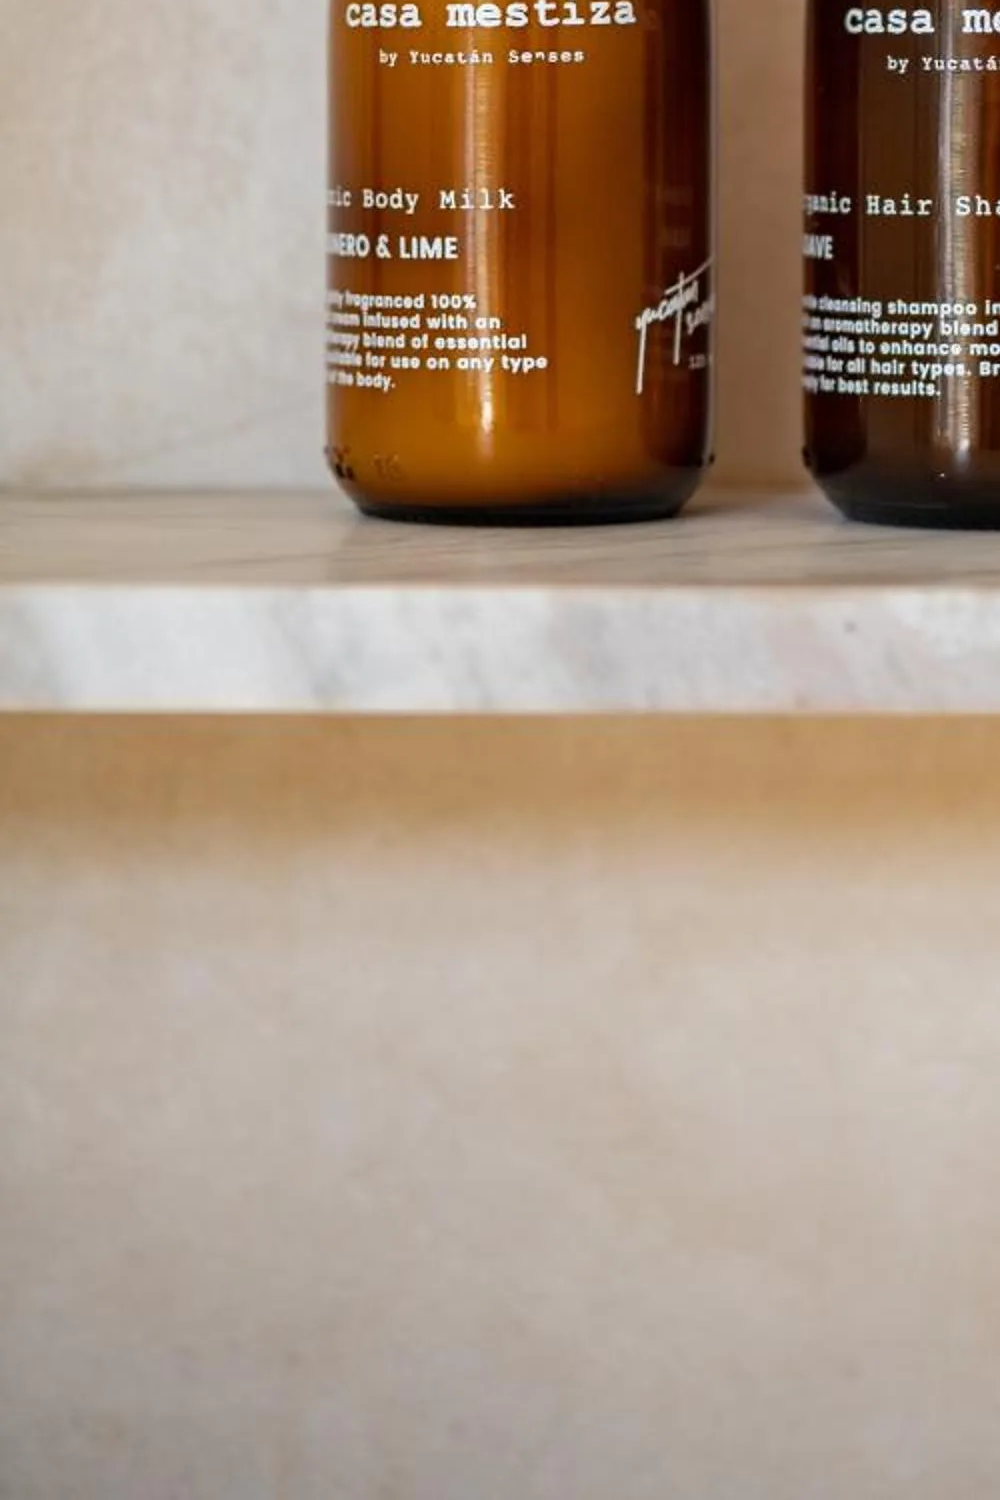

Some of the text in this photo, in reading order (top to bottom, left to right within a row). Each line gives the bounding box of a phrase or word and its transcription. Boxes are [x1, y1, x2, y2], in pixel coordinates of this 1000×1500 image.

[345, 2, 422, 28] casa
[845, 8, 934, 34] casa
[379, 50, 399, 66] by
[409, 50, 493, 65] Yucatán
[887, 56, 909, 72] by
[362, 188, 419, 214] Body
[439, 188, 516, 210] Milk
[865, 193, 933, 216] Hair
[375, 234, 392, 258] &
[399, 236, 459, 259] LIME
[431, 294, 477, 309] 100%
[887, 300, 977, 317] shampoo
[426, 313, 468, 329] with
[475, 316, 501, 329] an
[940, 319, 998, 337] blend
[363, 332, 405, 349] blend
[410, 333, 428, 349] of
[434, 335, 527, 349] essential
[858, 339, 875, 354] to
[880, 340, 962, 357] enhance
[366, 352, 386, 368] for
[390, 355, 420, 369] use
[426, 357, 449, 370] on
[457, 357, 494, 373] any
[501, 356, 547, 373] type
[847, 358, 866, 374] all
[870, 359, 905, 375] hair
[911, 360, 972, 380] types.
[356, 371, 396, 393] body.
[837, 377, 869, 394] best
[874, 380, 941, 398] results.
